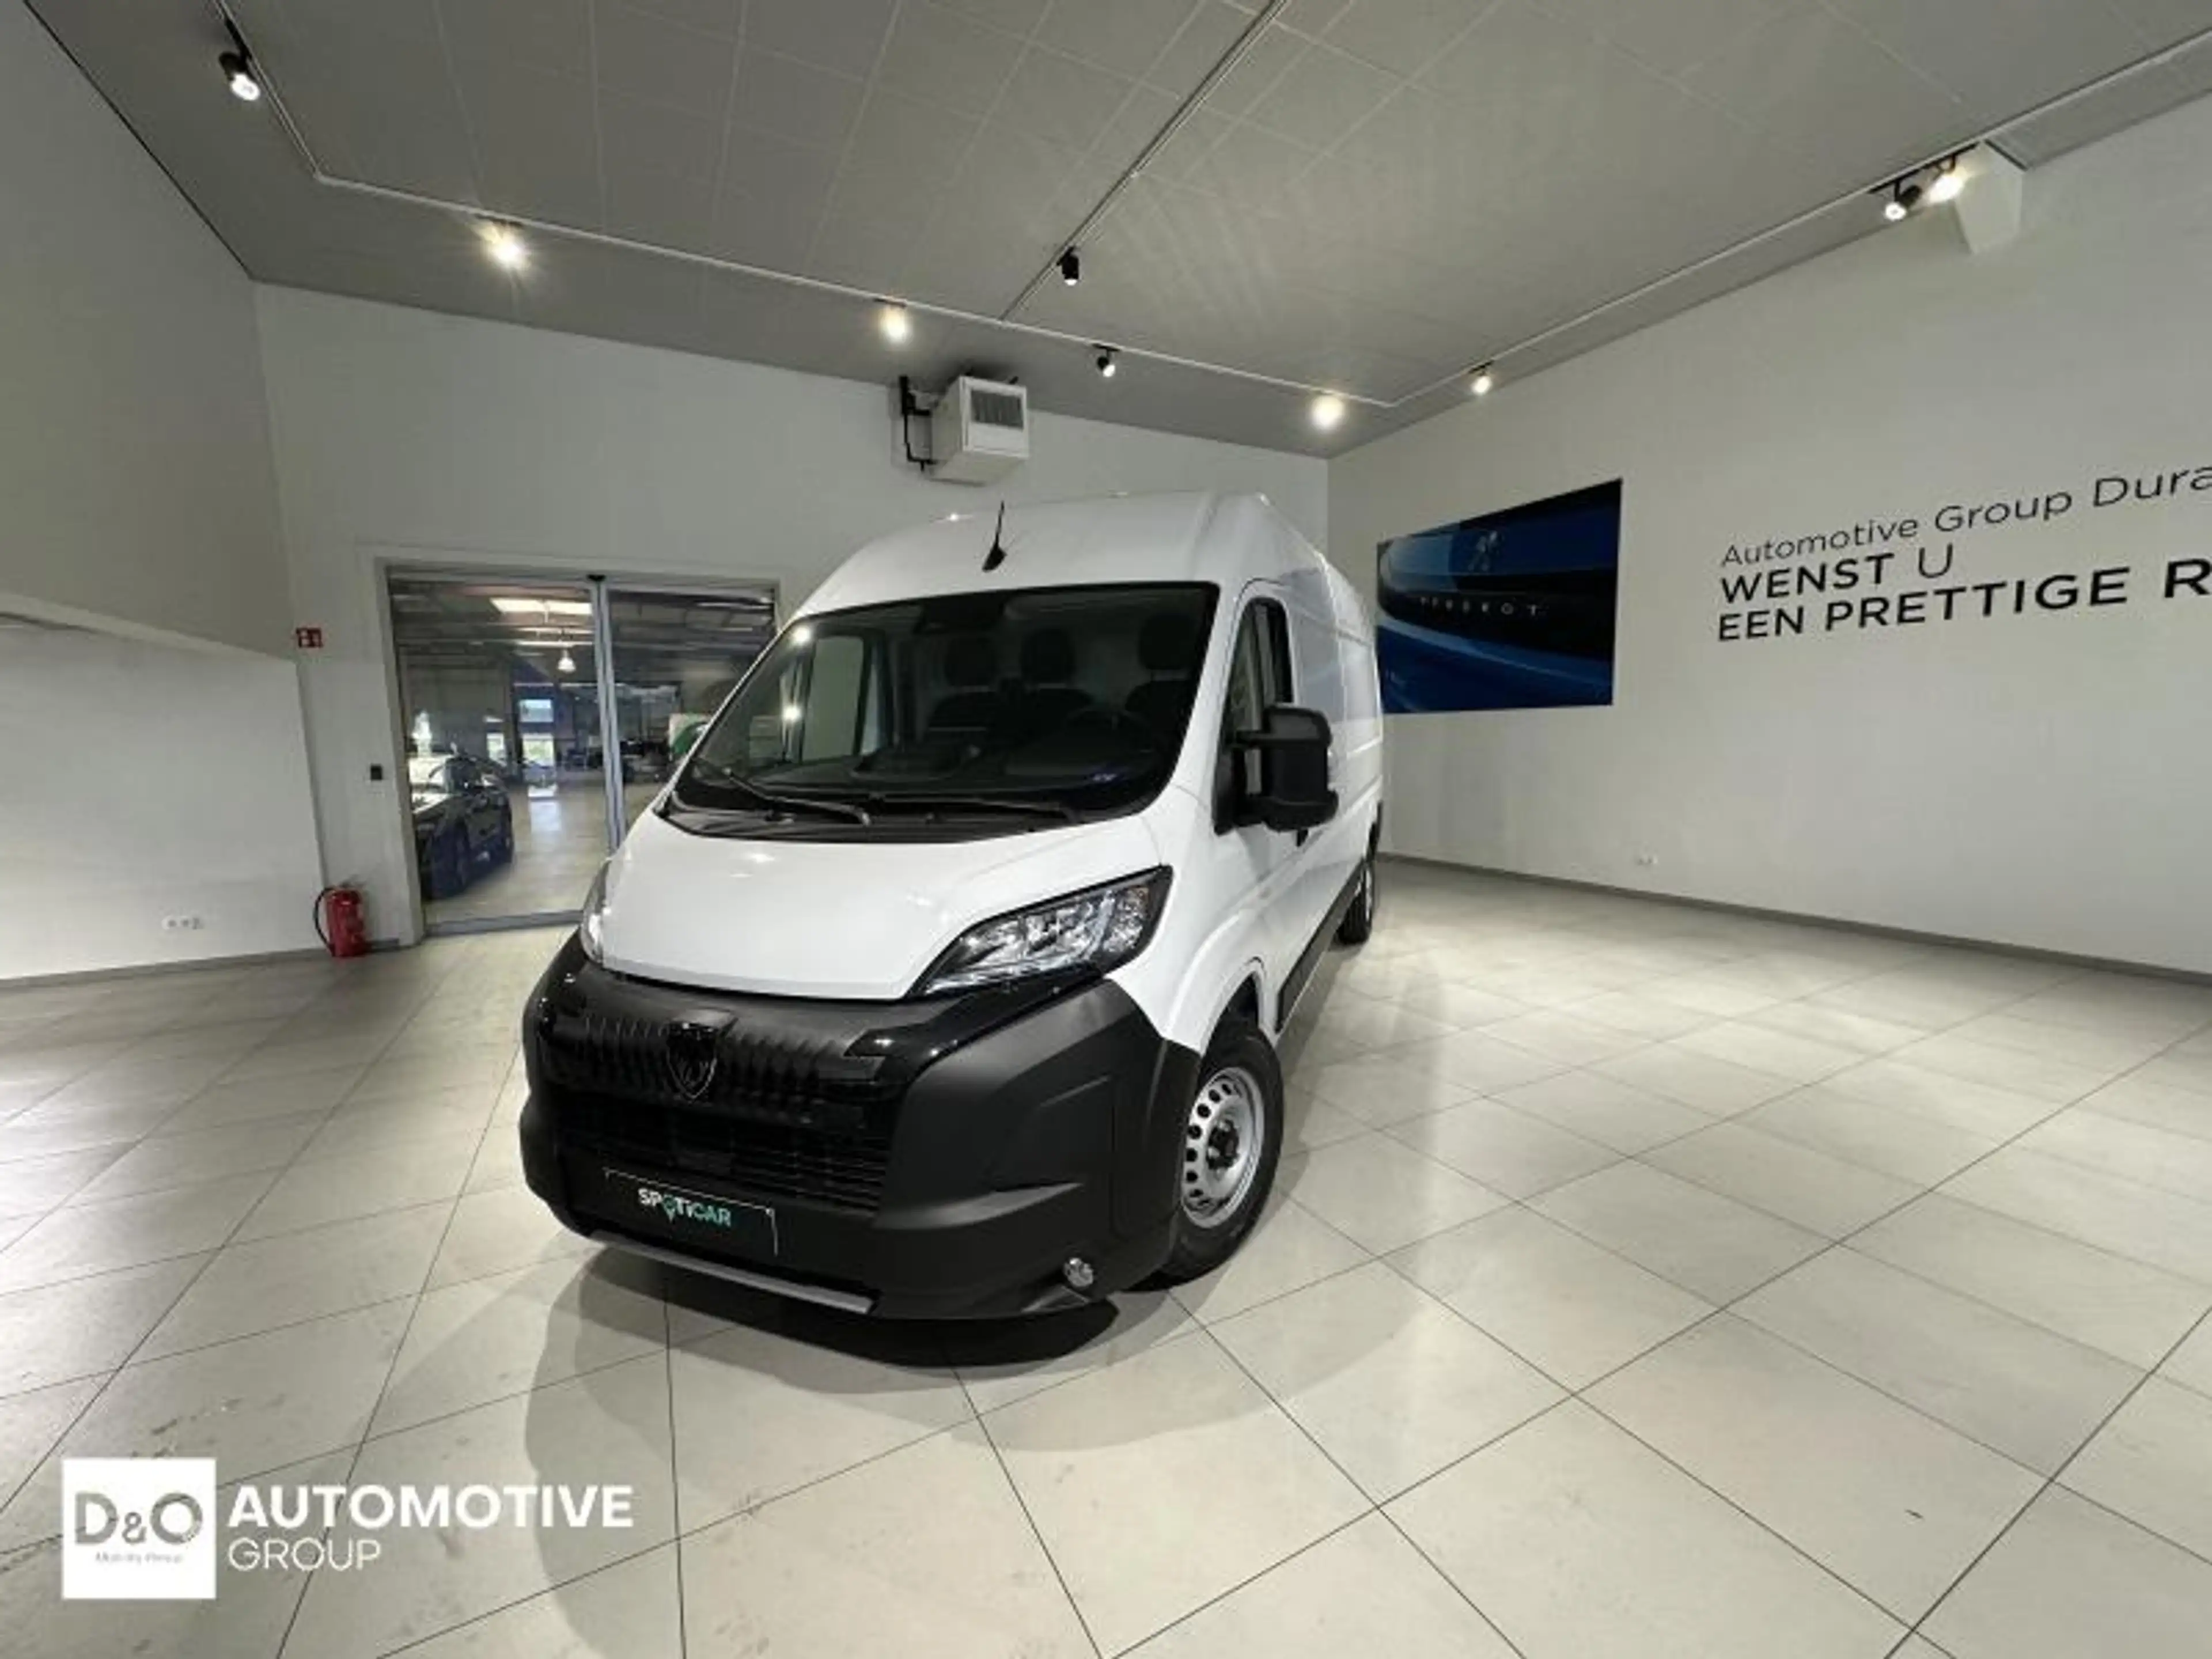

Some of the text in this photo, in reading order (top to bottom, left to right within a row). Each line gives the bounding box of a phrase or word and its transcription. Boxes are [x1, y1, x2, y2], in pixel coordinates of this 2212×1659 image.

[1720, 517, 1919, 568] Automotive
[1934, 491, 2073, 532] Group
[1718, 605, 1805, 641] EEN
[1825, 566, 2130, 631] PRETTIGE
[1721, 543, 1953, 603] WENST U
